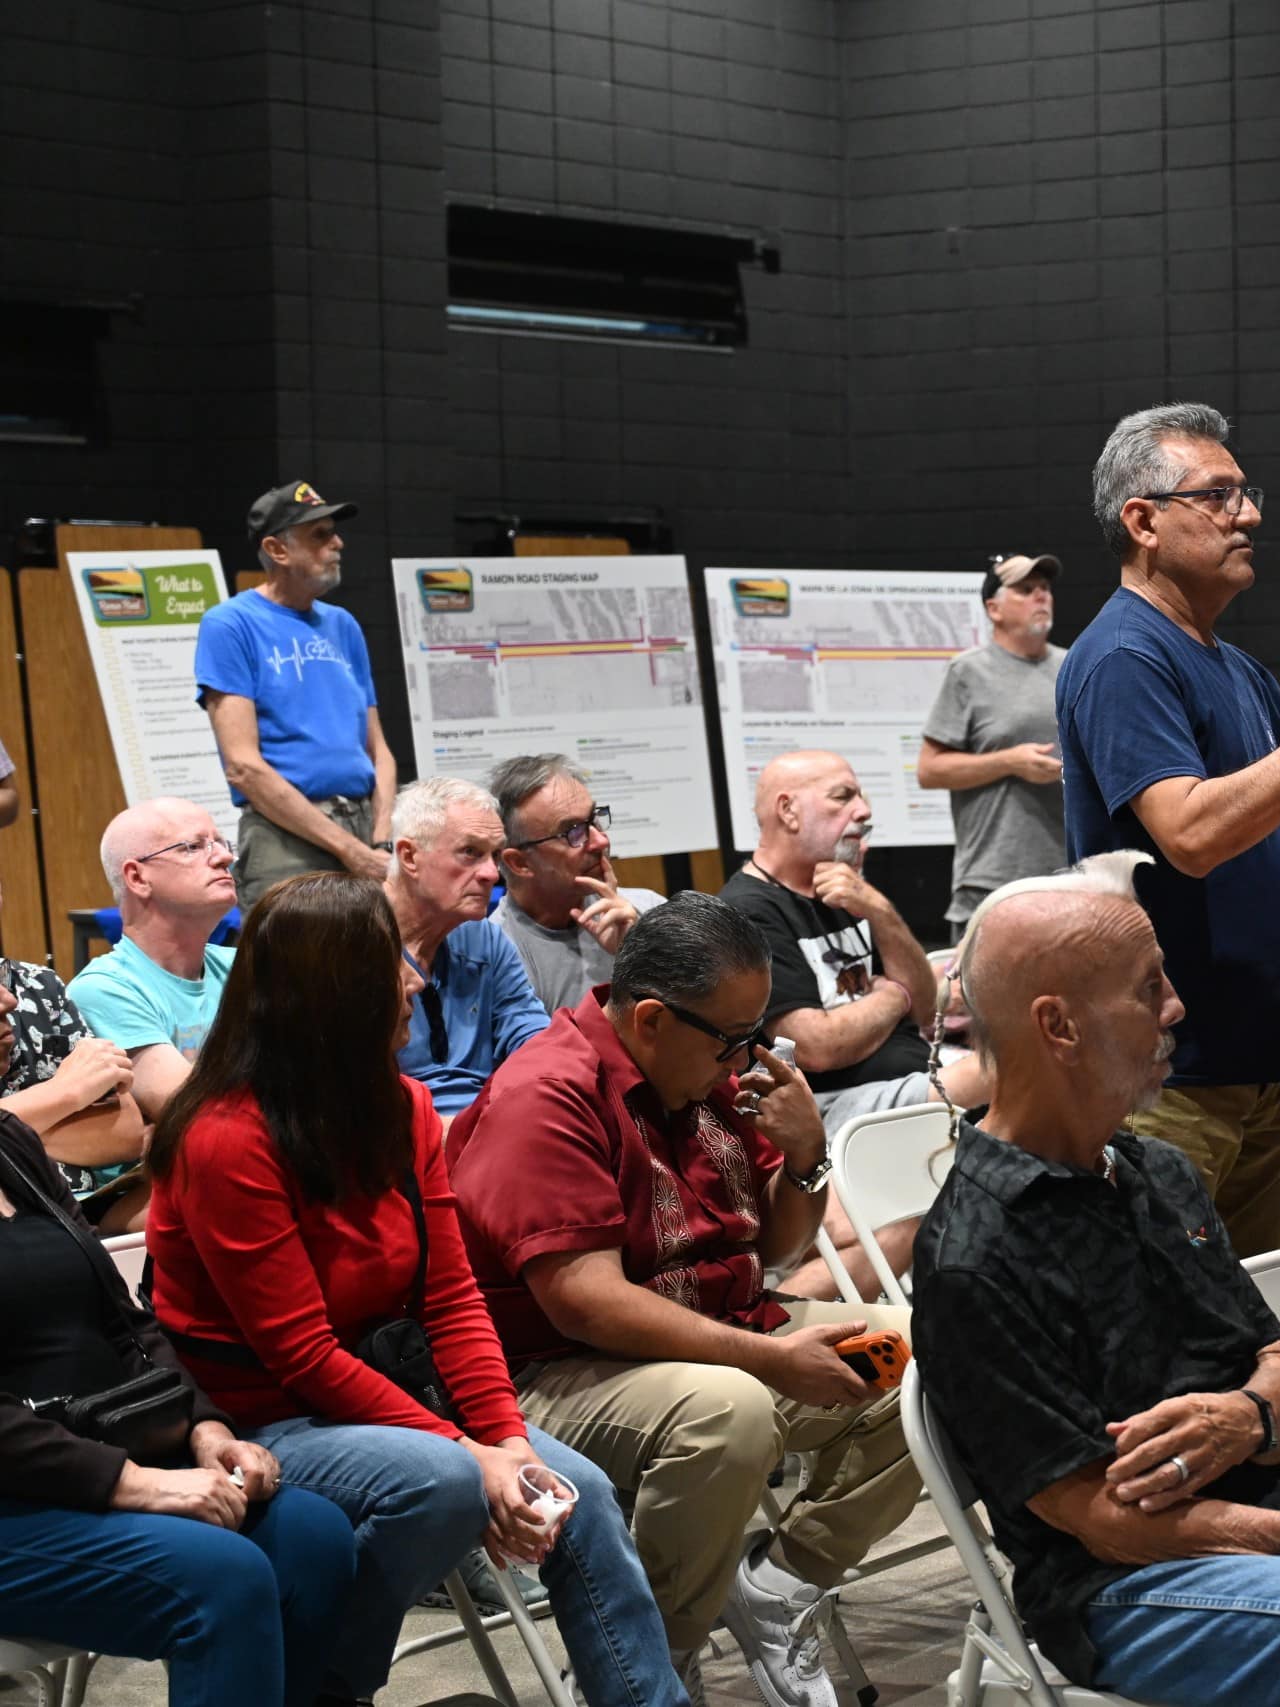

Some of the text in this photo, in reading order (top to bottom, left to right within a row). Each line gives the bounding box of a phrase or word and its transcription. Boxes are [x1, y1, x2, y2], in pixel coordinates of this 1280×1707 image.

[155, 574, 203, 593] What to
[481, 572, 599, 584] RAMON ROAD STAGING MAP
[166, 596, 206, 619] Expect
[432, 729, 458, 739] Staging
[460, 728, 484, 738] Legend
